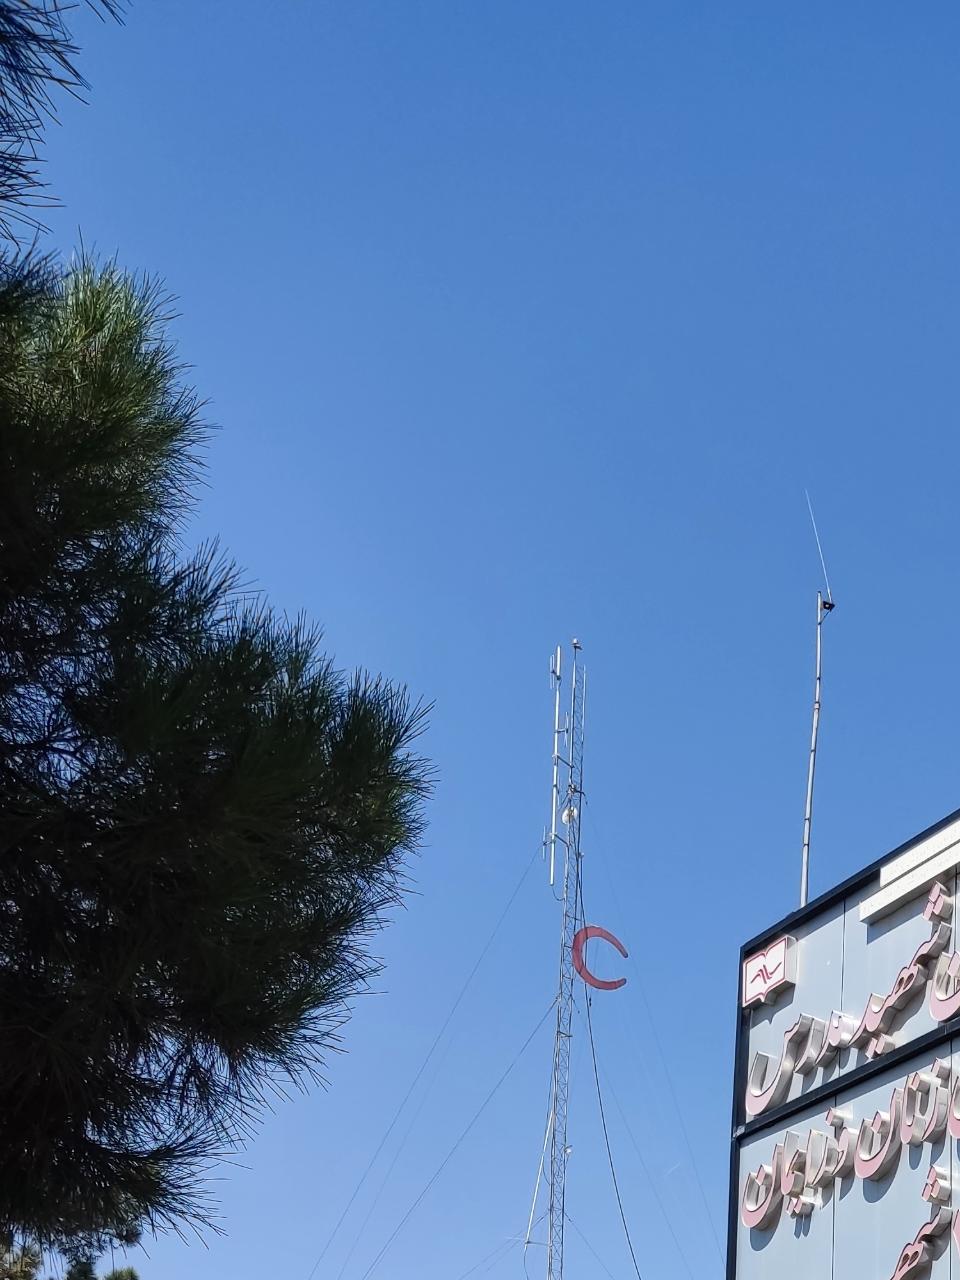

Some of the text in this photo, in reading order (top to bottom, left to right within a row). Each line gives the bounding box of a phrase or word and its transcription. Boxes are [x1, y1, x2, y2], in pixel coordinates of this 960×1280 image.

[849, 879, 952, 1060] شهید
[740, 1106, 838, 1229] زایمان
[854, 1057, 948, 1180] زنان
